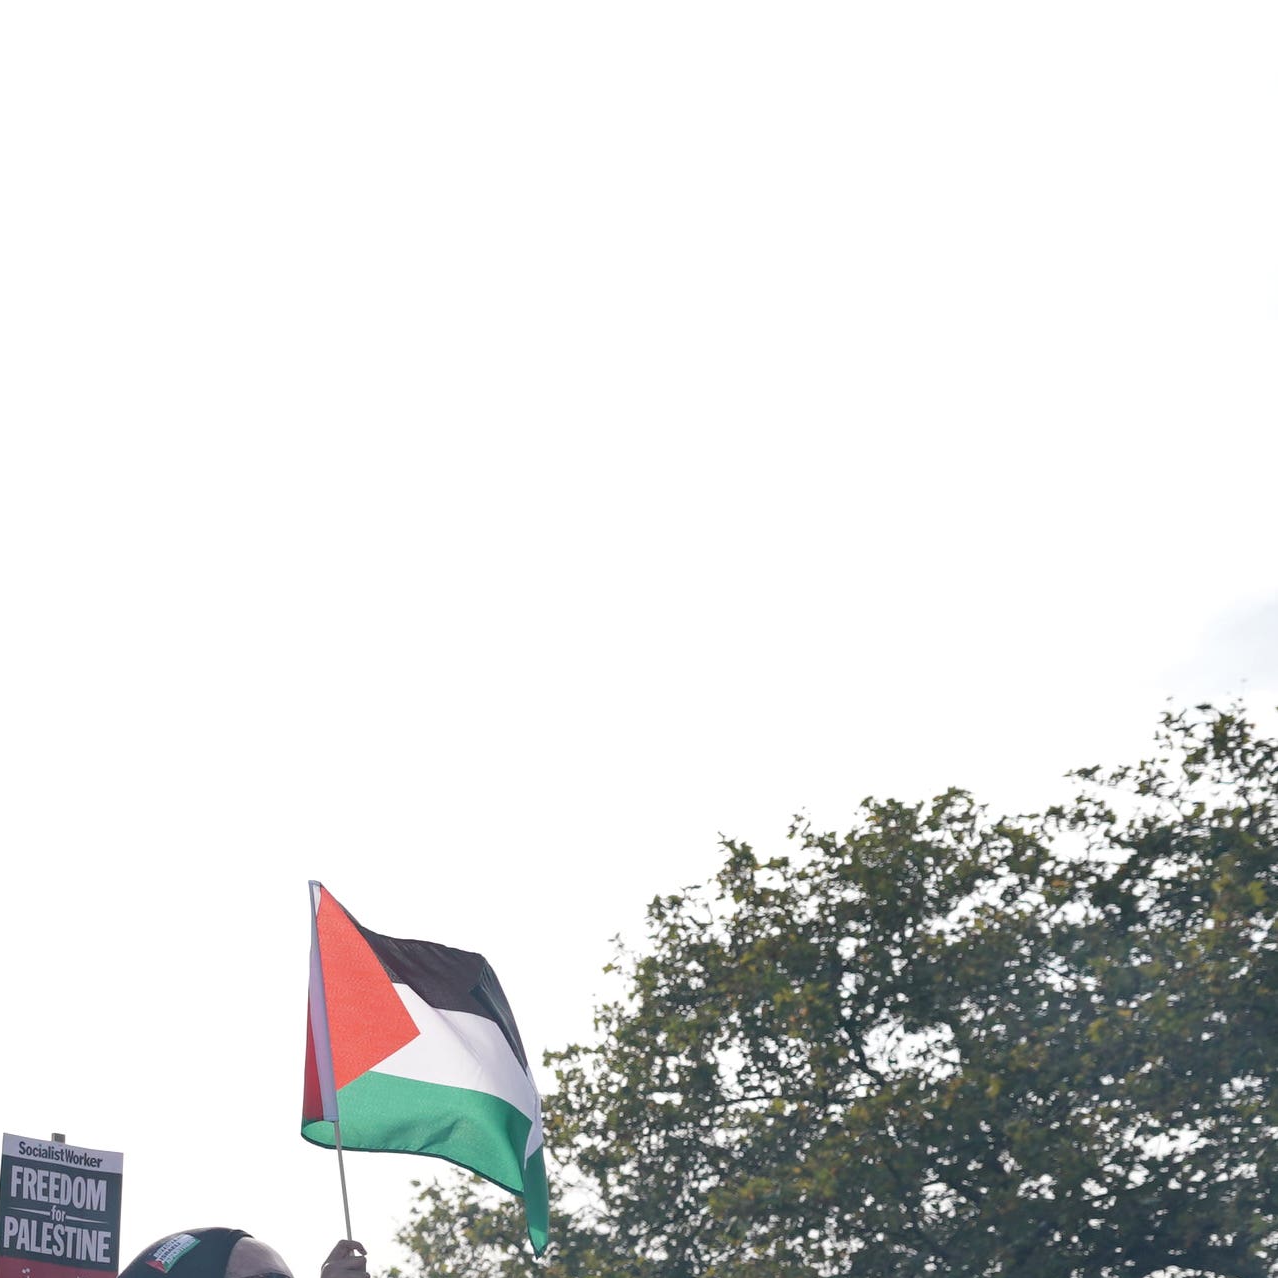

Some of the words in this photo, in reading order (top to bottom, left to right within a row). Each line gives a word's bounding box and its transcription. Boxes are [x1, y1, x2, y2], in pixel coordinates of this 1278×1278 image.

[10, 1165, 107, 1212] FREEDOM
[51, 1205, 66, 1222] for
[3, 1215, 112, 1264] PALESTINE
